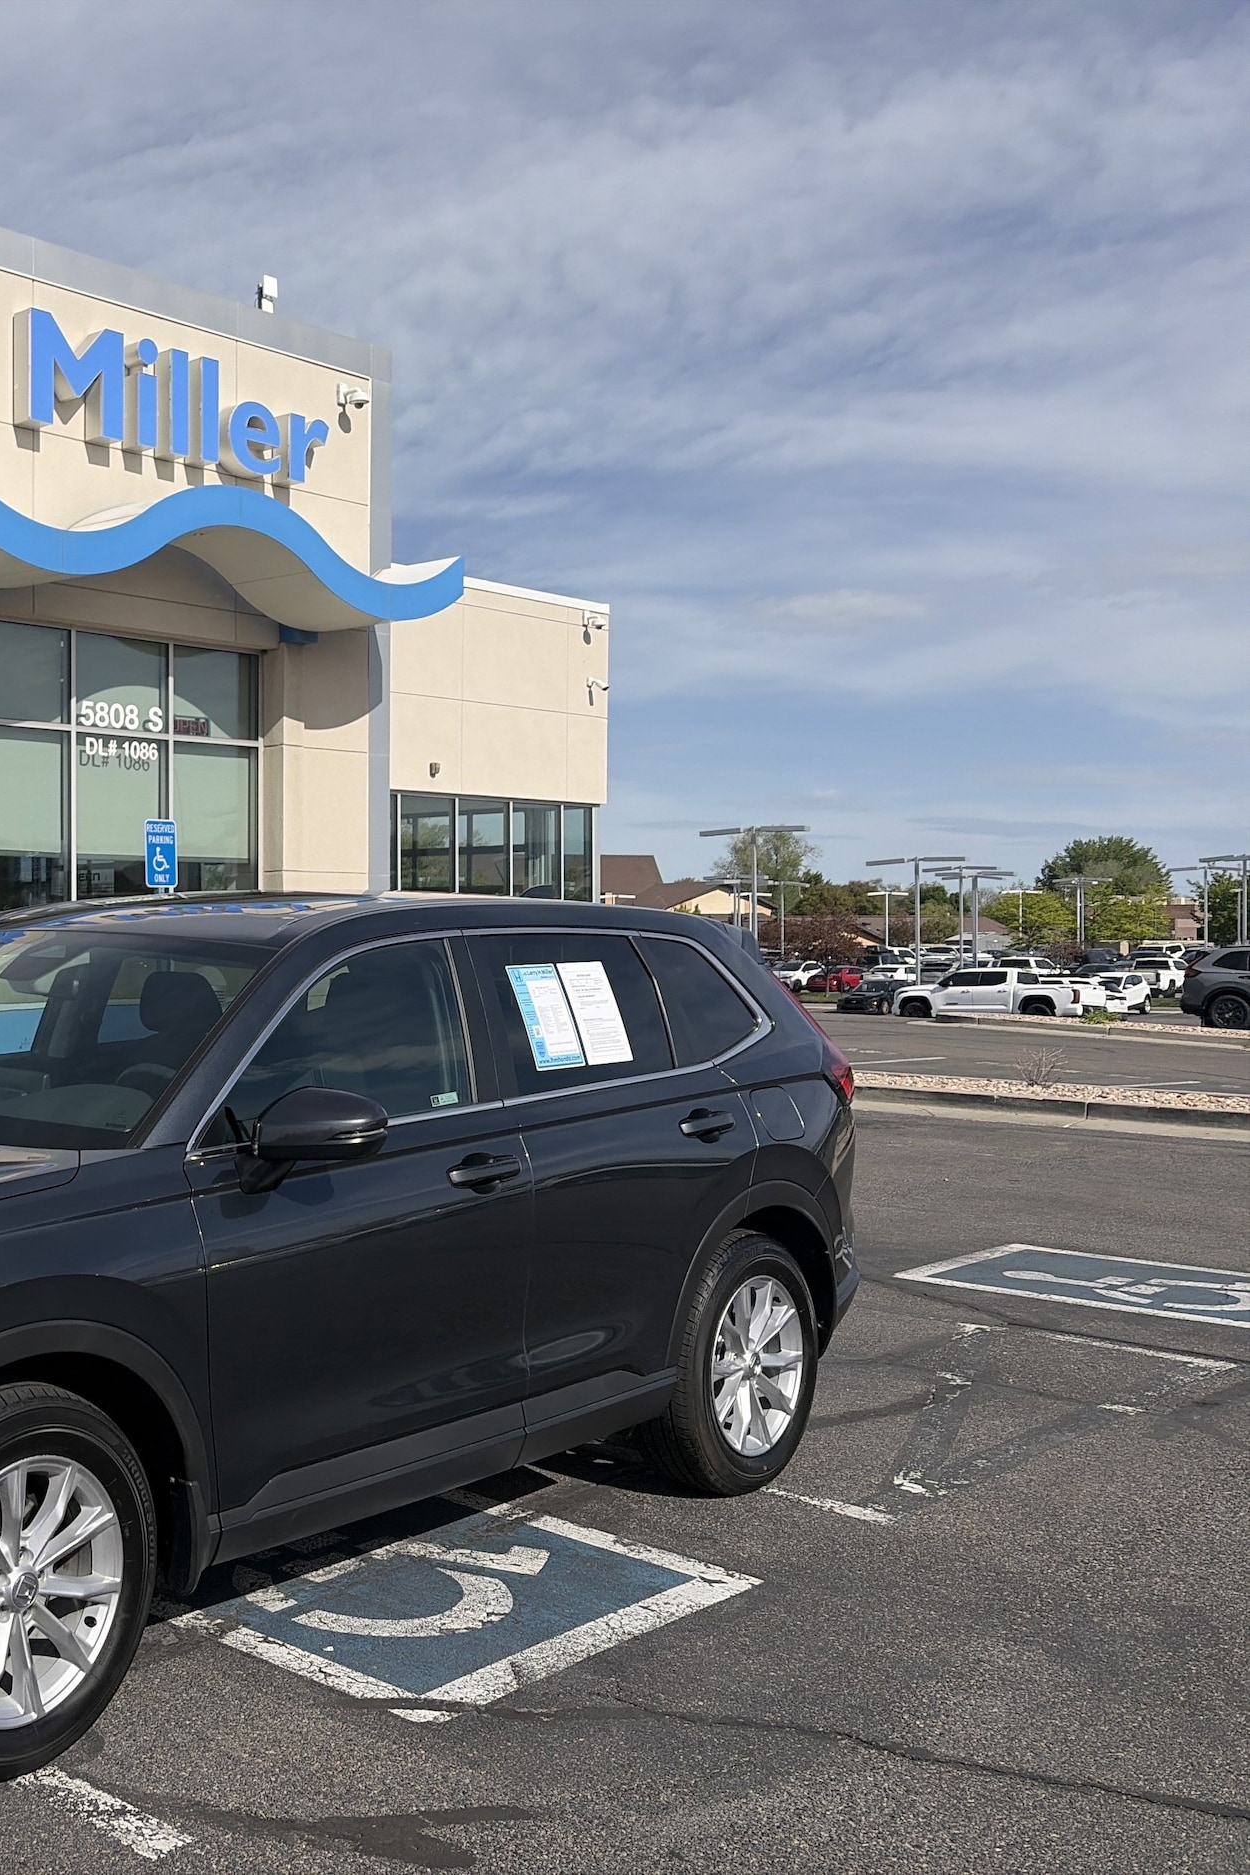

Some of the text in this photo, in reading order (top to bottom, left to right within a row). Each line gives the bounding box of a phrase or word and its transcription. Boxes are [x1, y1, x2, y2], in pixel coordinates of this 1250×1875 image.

[14, 307, 329, 484] Miller
[80, 700, 163, 732] 5808 S
[85, 736, 159, 760] DL# 1086
[146, 823, 175, 833] RESERVED
[148, 834, 174, 844] PARKING
[154, 873, 170, 883] ONLY
